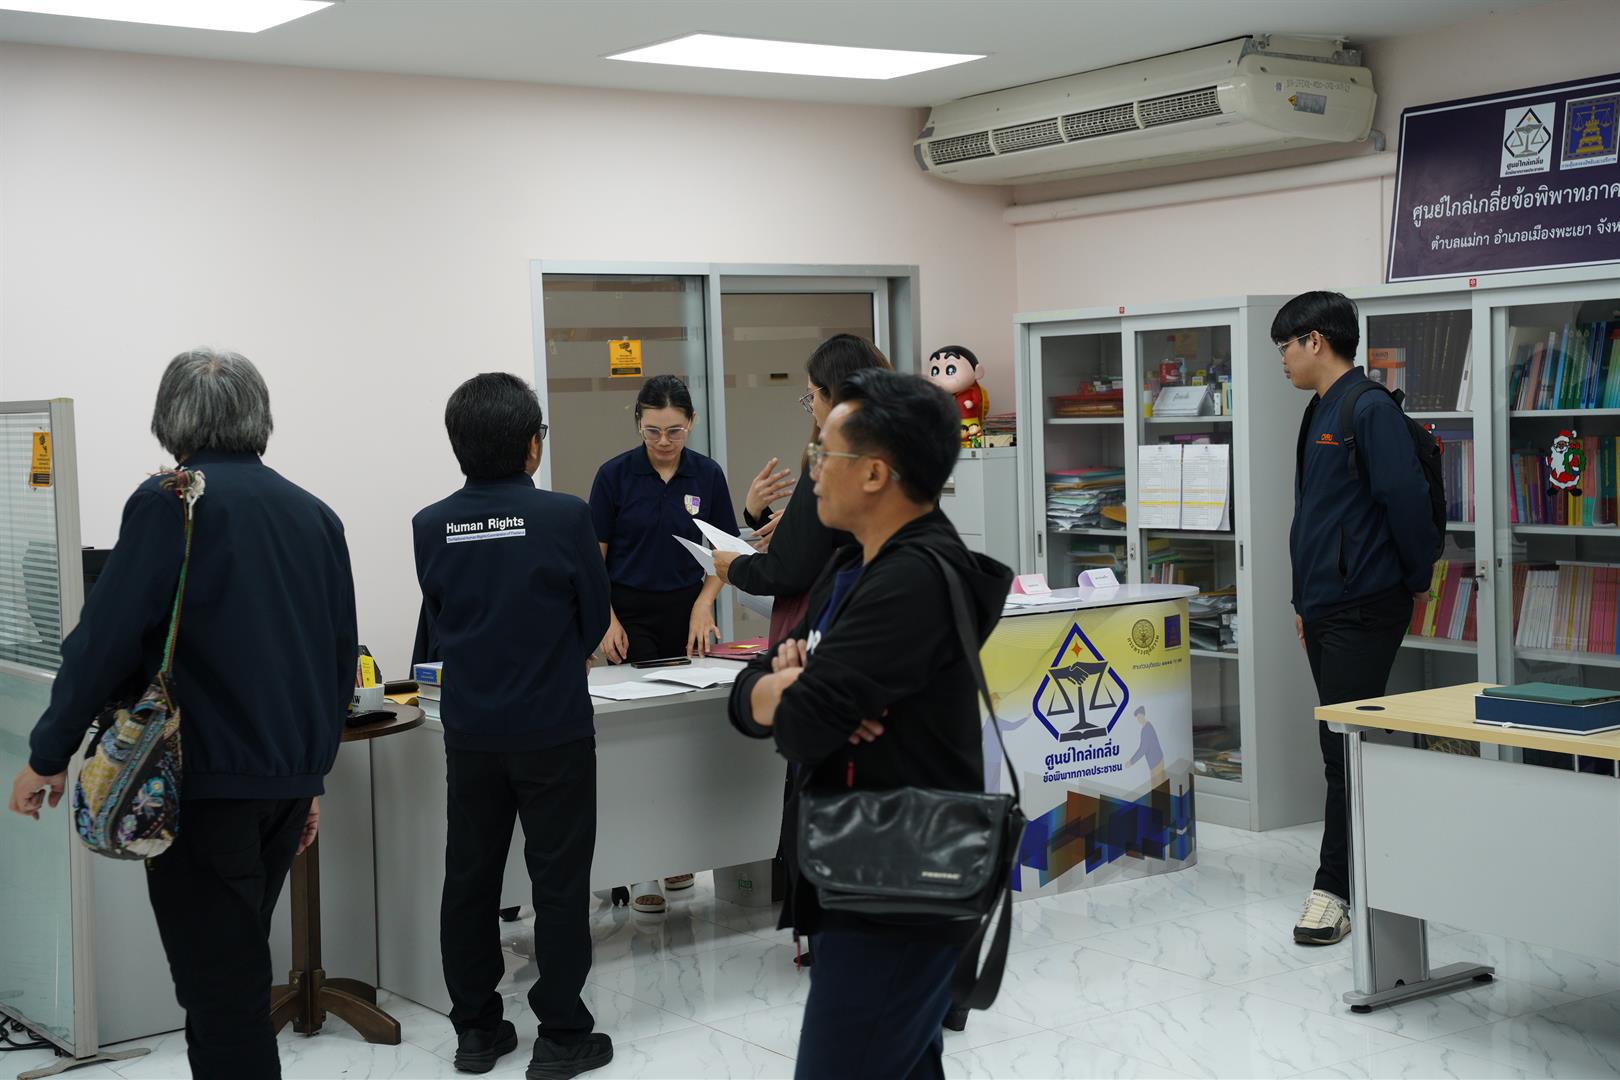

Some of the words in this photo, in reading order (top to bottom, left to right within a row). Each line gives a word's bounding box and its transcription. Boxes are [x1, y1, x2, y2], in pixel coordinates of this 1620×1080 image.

[1431, 234, 1490, 250] ตำบลแม่กา
[1494, 224, 1592, 245] อำเภอเมืองพะเยา
[446, 522, 483, 533] Human
[488, 517, 525, 530] Rights
[1045, 738, 1120, 770] ศูนย์ไกล่เกลี่ย
[1043, 763, 1123, 783] ข้อพิพาทภาคประชาชน
